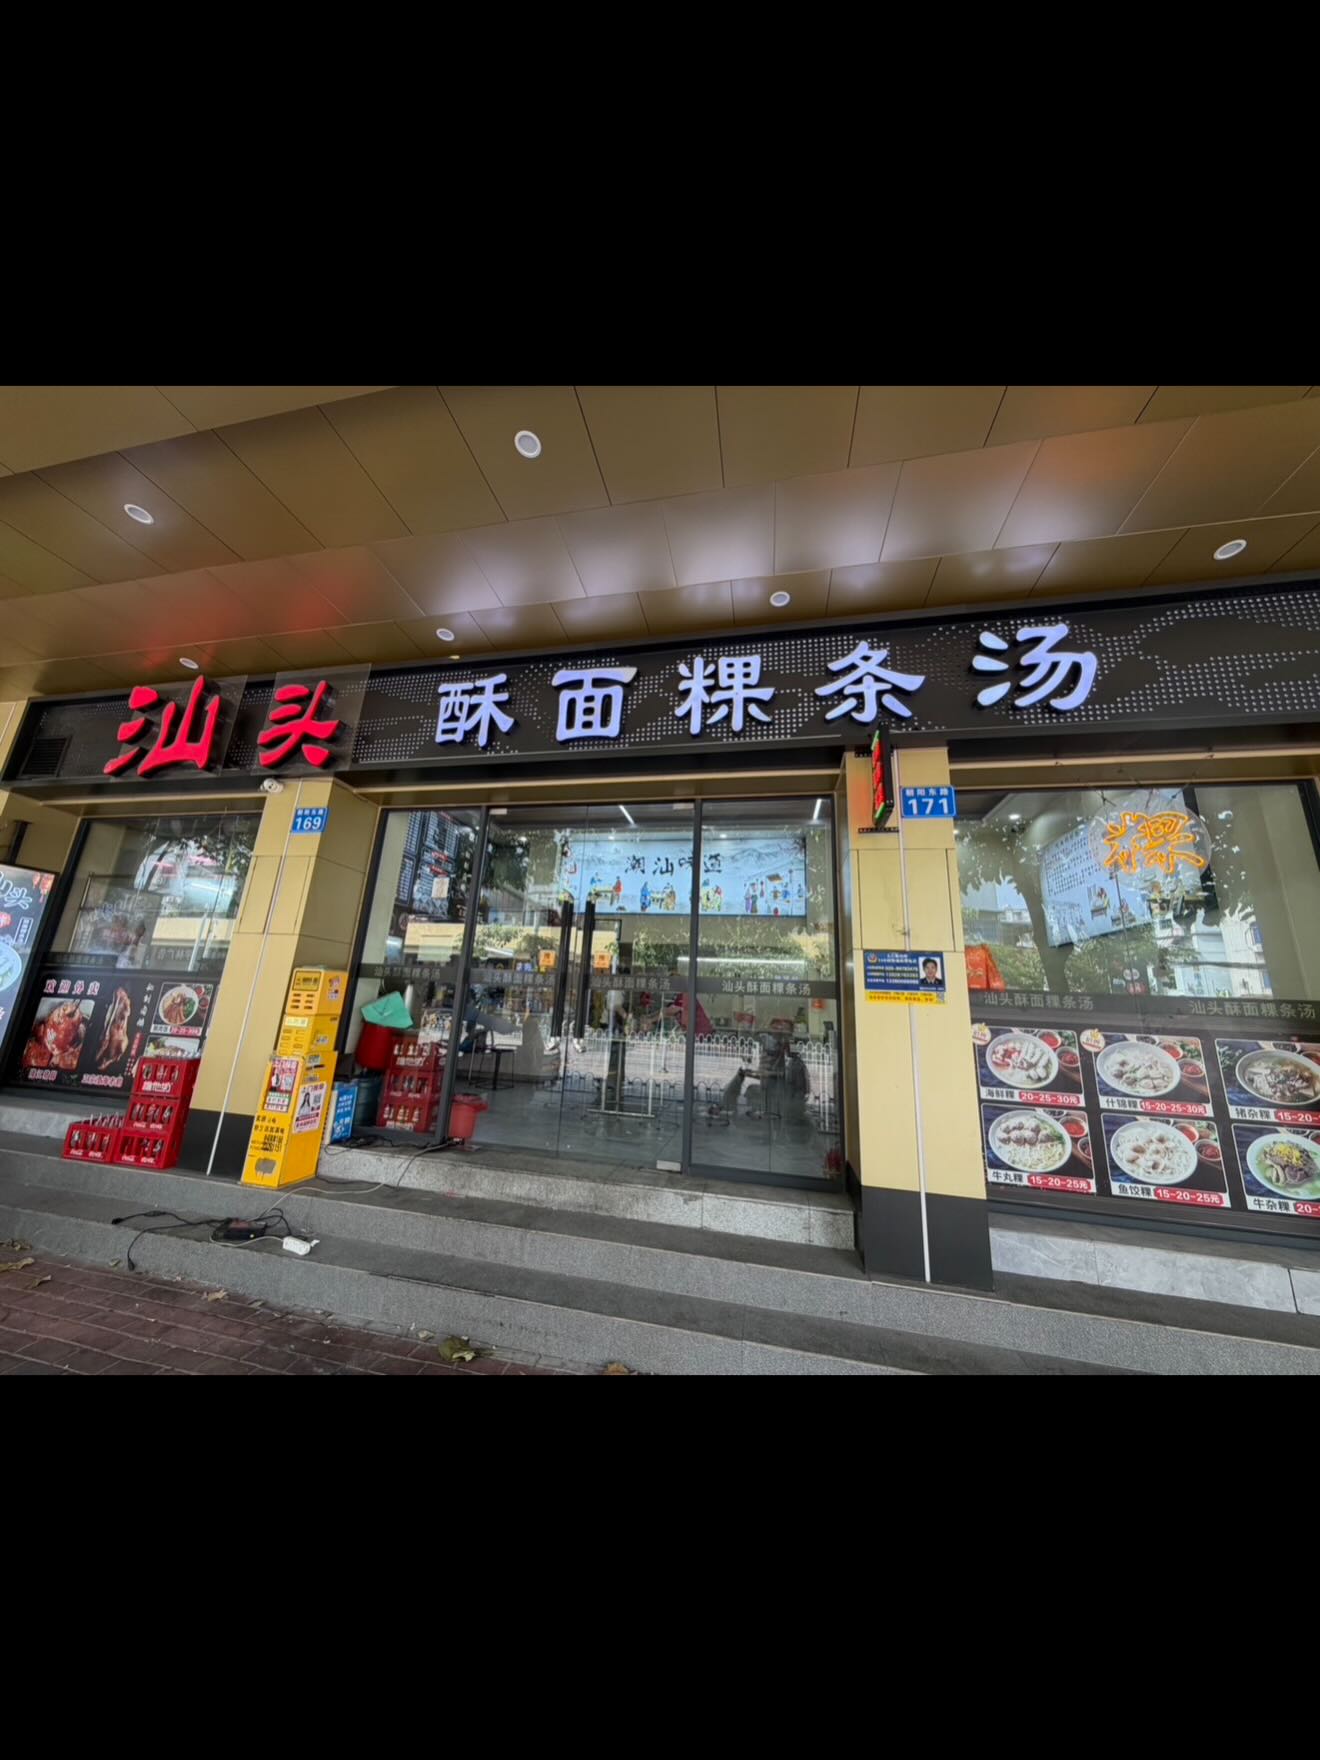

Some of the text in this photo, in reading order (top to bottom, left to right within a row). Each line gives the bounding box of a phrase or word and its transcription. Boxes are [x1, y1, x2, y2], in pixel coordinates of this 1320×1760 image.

[104, 623, 1098, 776] 汕头 酥面粿条汤
[908, 798, 949, 815] 171
[295, 816, 322, 831] 169
[722, 979, 811, 996] 汕头酥面粿条汤
[984, 991, 1095, 1010] 汕头酥面粿条汤
[1190, 1000, 1317, 1019] 汕头酥面粿条汤
[985, 1088, 1015, 1100] 海鲜粿
[1105, 1098, 1138, 1110] 什锦粿
[1235, 1108, 1271, 1120] 猪杂粿
[992, 1170, 1024, 1183] 牛丸粿
[1118, 1184, 1152, 1197] 鱼饺粿
[1253, 1200, 1290, 1212] 牛杂粿
